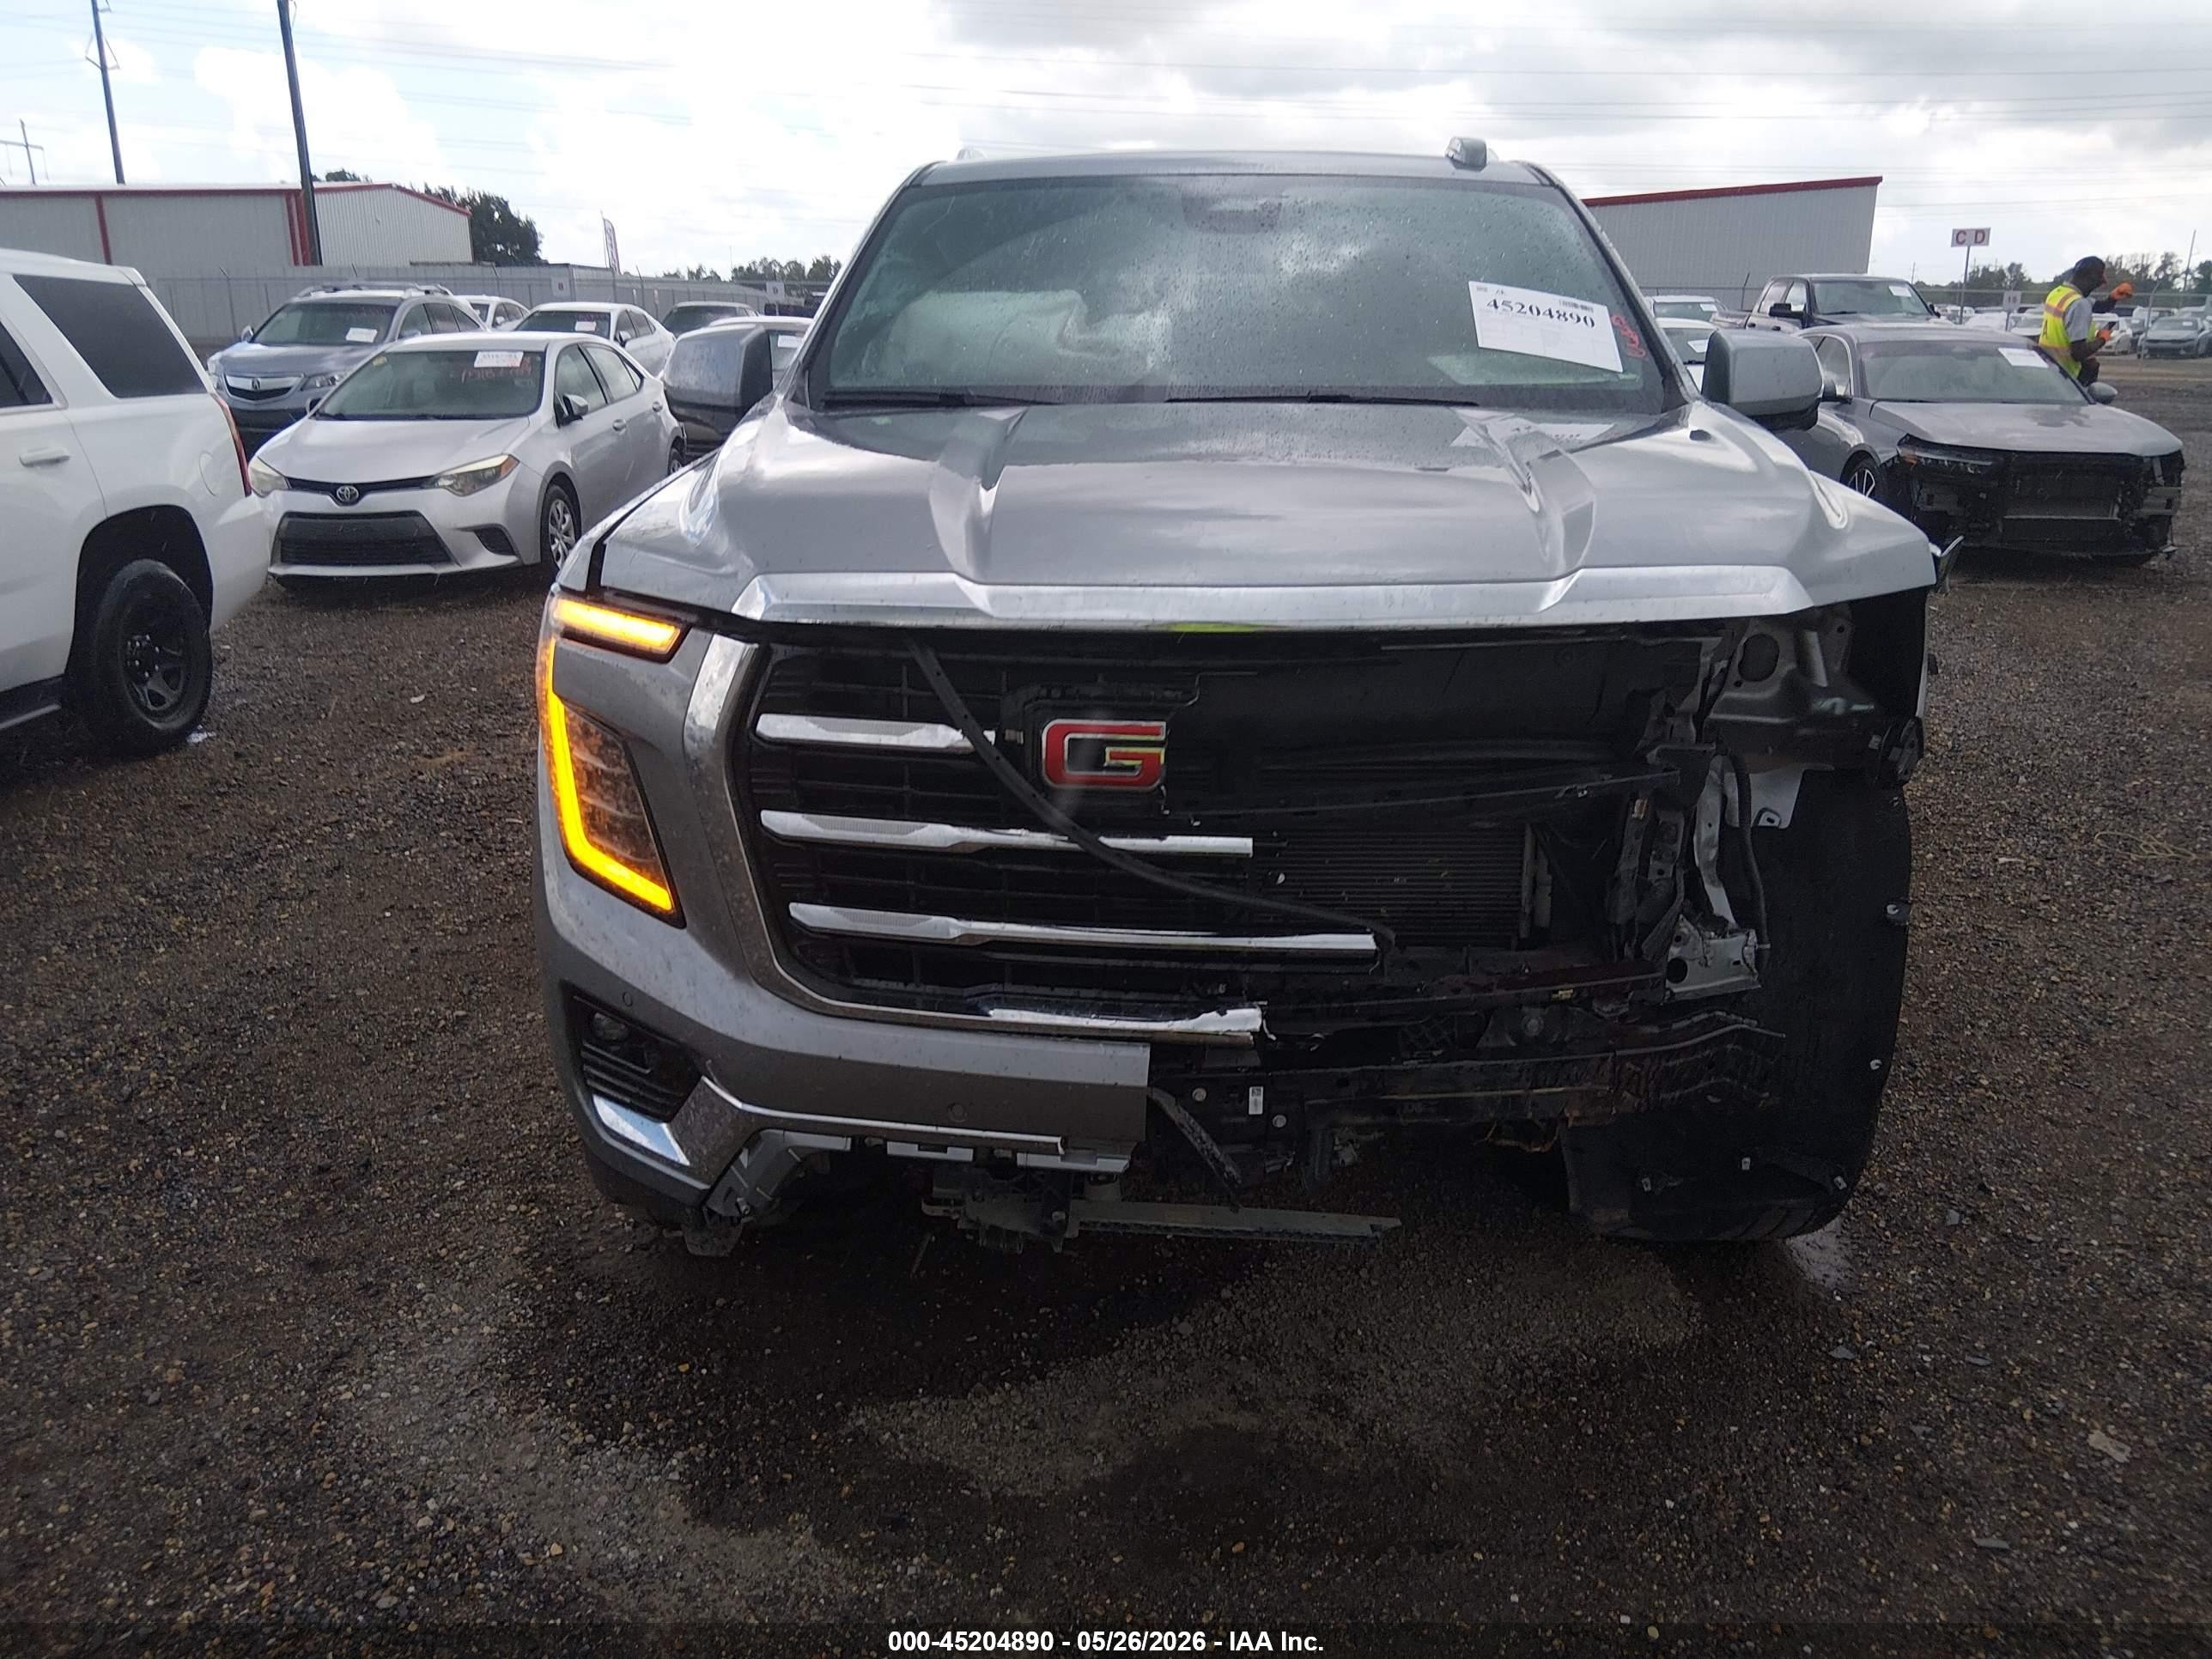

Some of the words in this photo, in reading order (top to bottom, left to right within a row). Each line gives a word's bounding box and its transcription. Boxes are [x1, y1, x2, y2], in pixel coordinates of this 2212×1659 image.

[1955, 229, 1967, 246] C
[1974, 228, 1986, 245] D
[1486, 298, 1595, 328] 45204890
[1042, 718, 1167, 791] G
